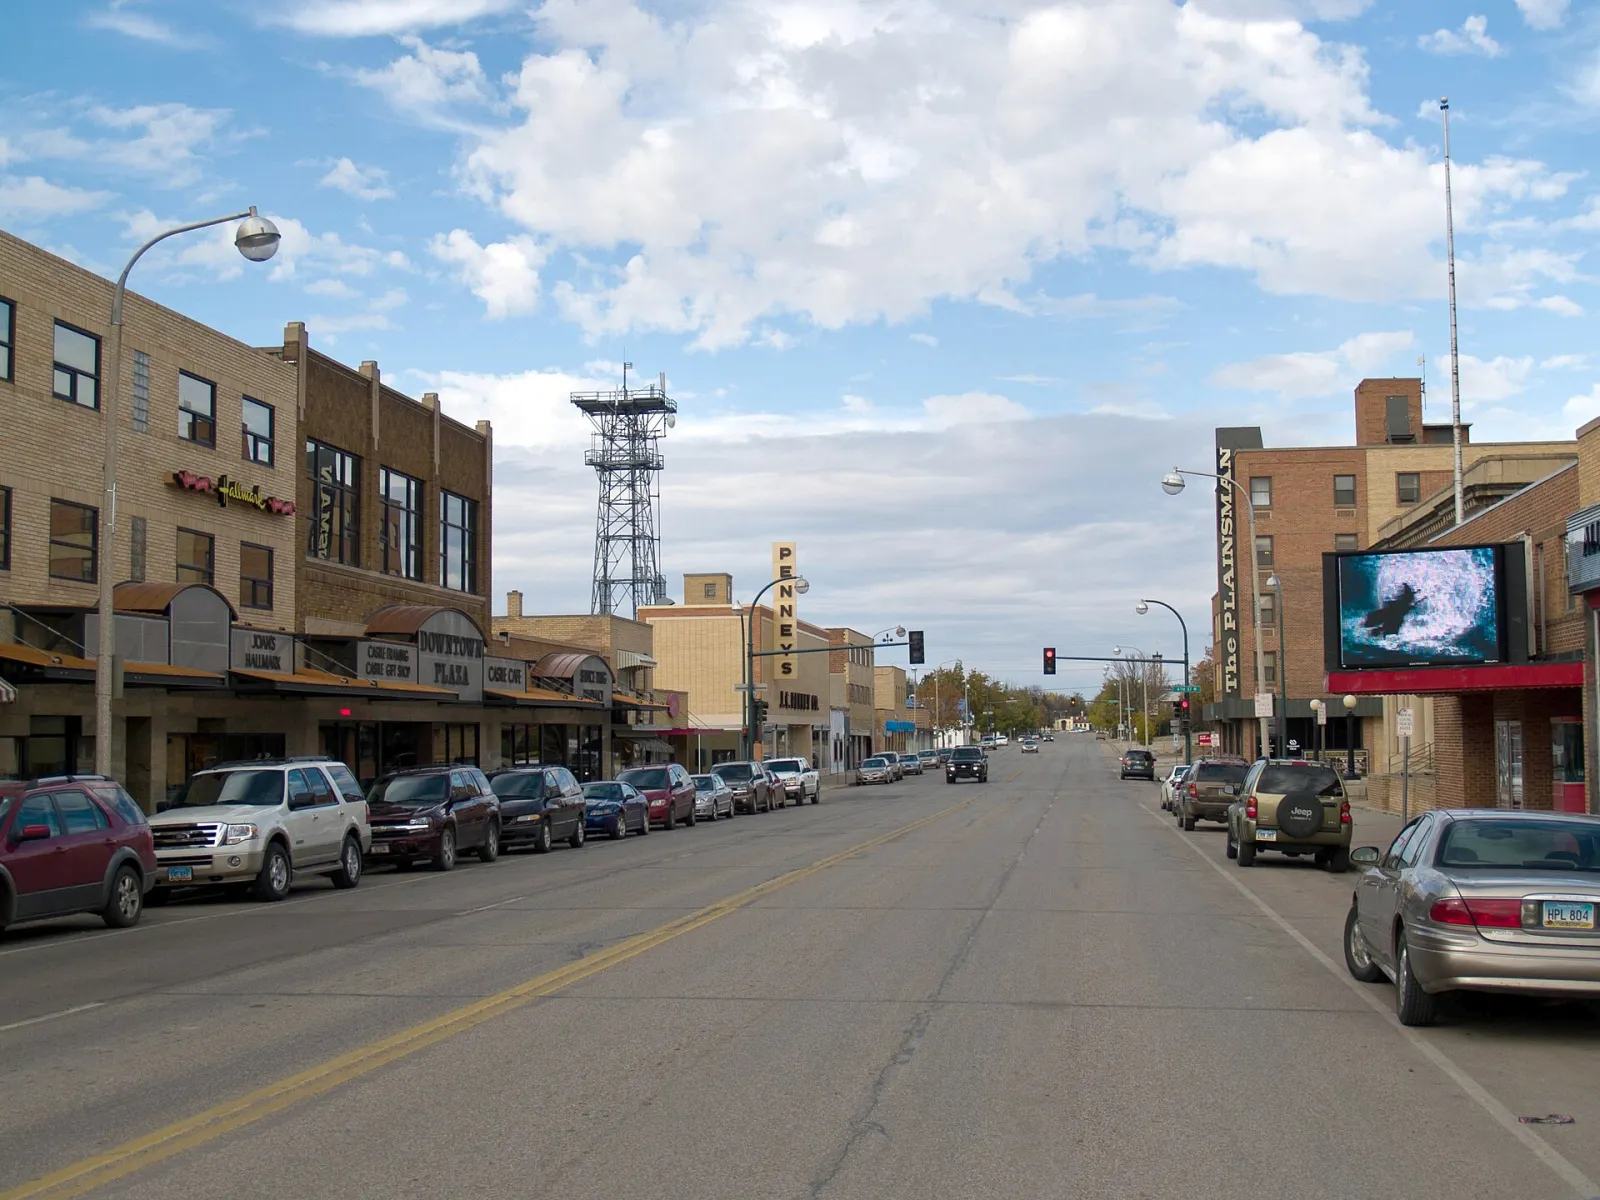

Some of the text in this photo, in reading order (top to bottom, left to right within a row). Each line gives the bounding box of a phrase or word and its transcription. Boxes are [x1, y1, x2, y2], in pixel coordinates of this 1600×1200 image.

[216, 474, 266, 509] Hallmark
[1219, 447, 1238, 693] The PLAINSMAN
[779, 547, 793, 675] PENNEYS
[419, 629, 482, 658] DOWNTOWN
[244, 652, 281, 670] HALLMARK
[433, 662, 470, 686] PLAZA
[488, 665, 507, 682] CASTLE
[1290, 806, 1313, 817] Jeep
[1547, 908, 1589, 922] HPL 804
